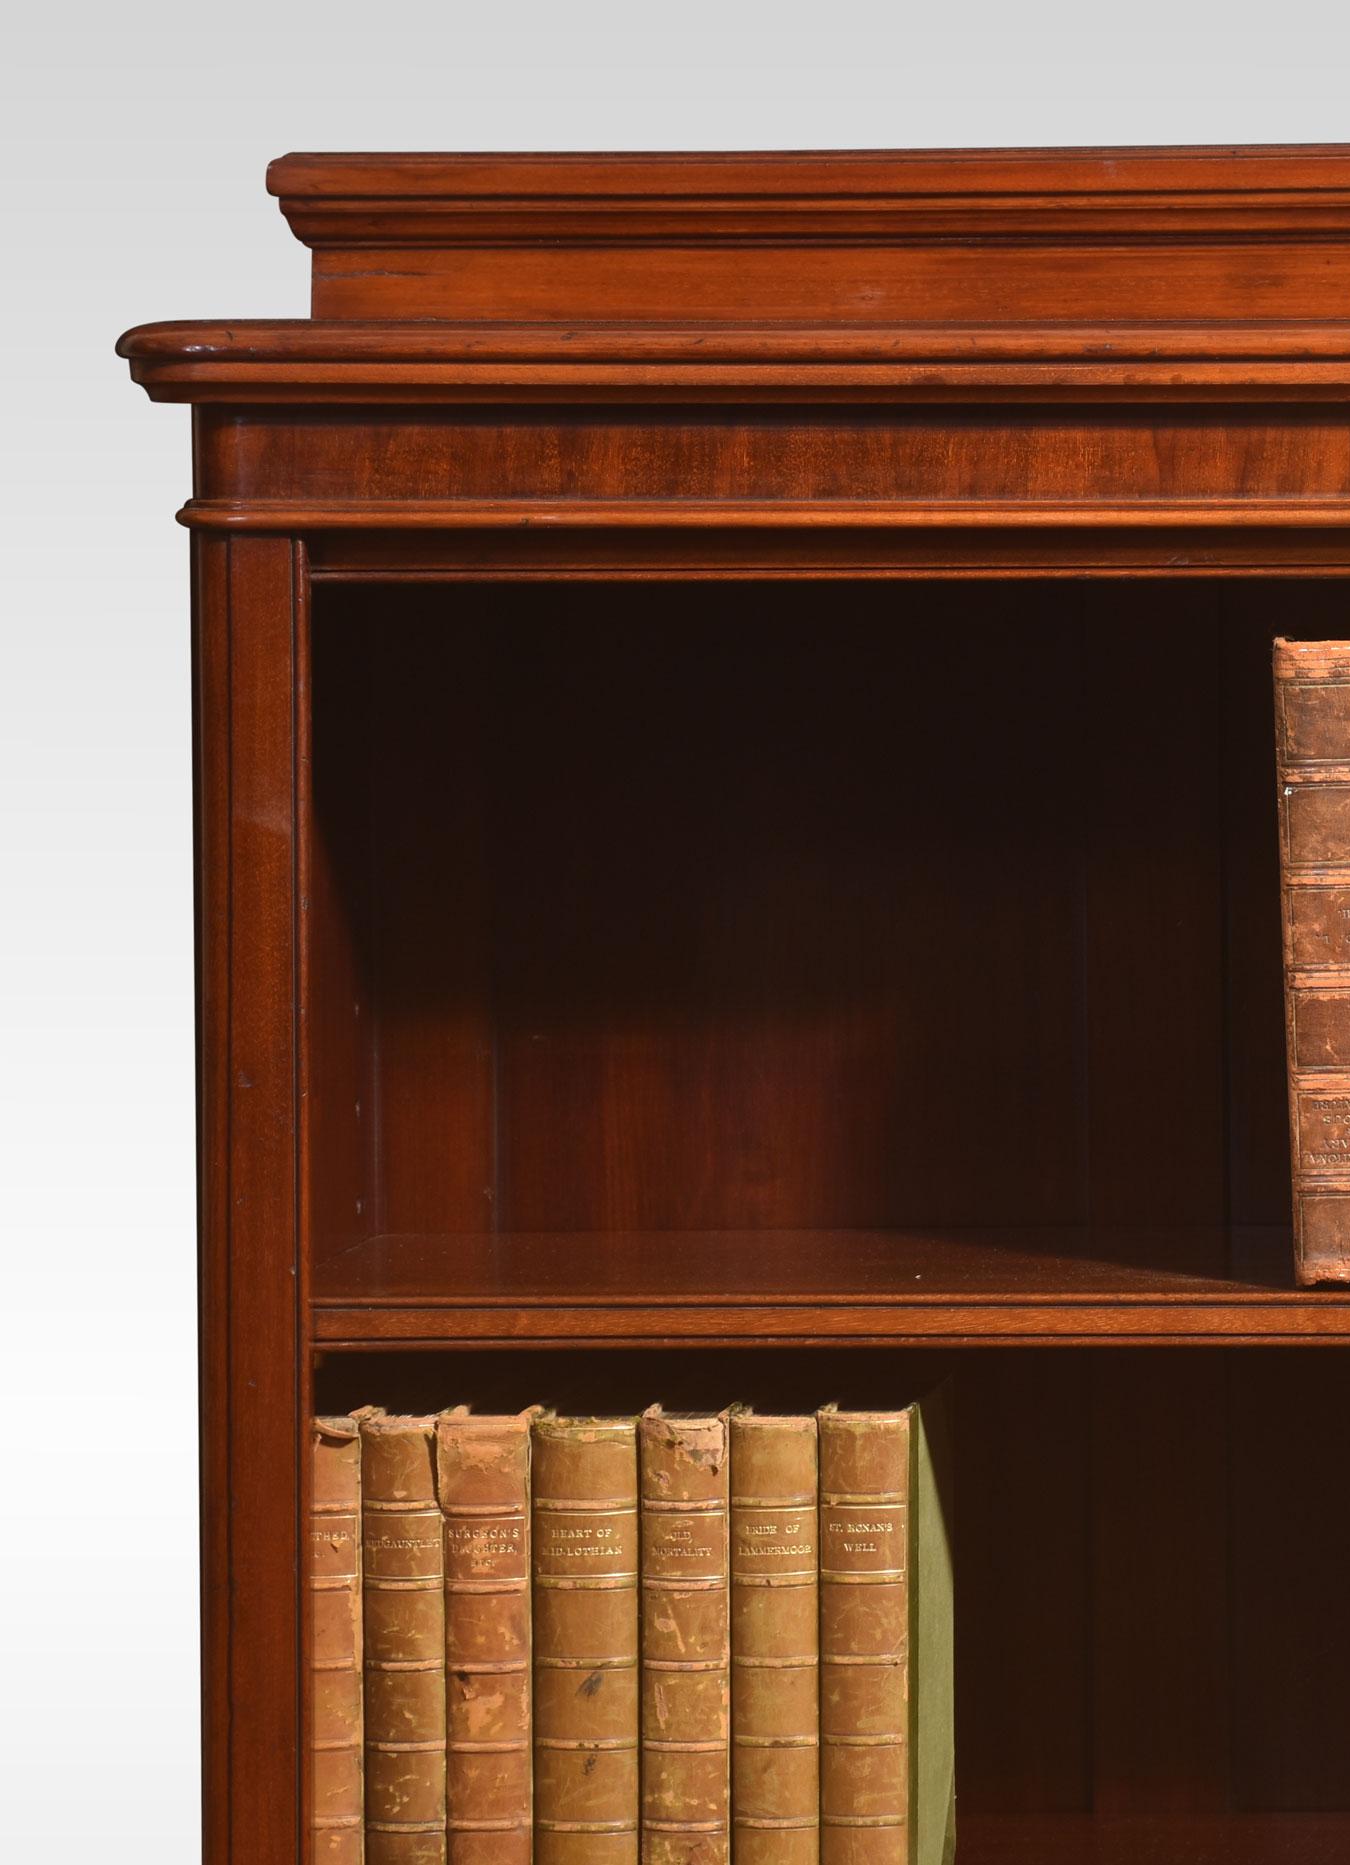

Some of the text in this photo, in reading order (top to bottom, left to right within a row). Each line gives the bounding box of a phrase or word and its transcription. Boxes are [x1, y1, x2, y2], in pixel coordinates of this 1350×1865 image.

[551, 1528, 613, 1538] HEART OF
[745, 1524, 800, 1535] BRIDE OF
[846, 1522, 893, 1533] RONAN'S
[447, 1528, 520, 1539] SURGEON'S
[843, 1542, 877, 1552] WELL
